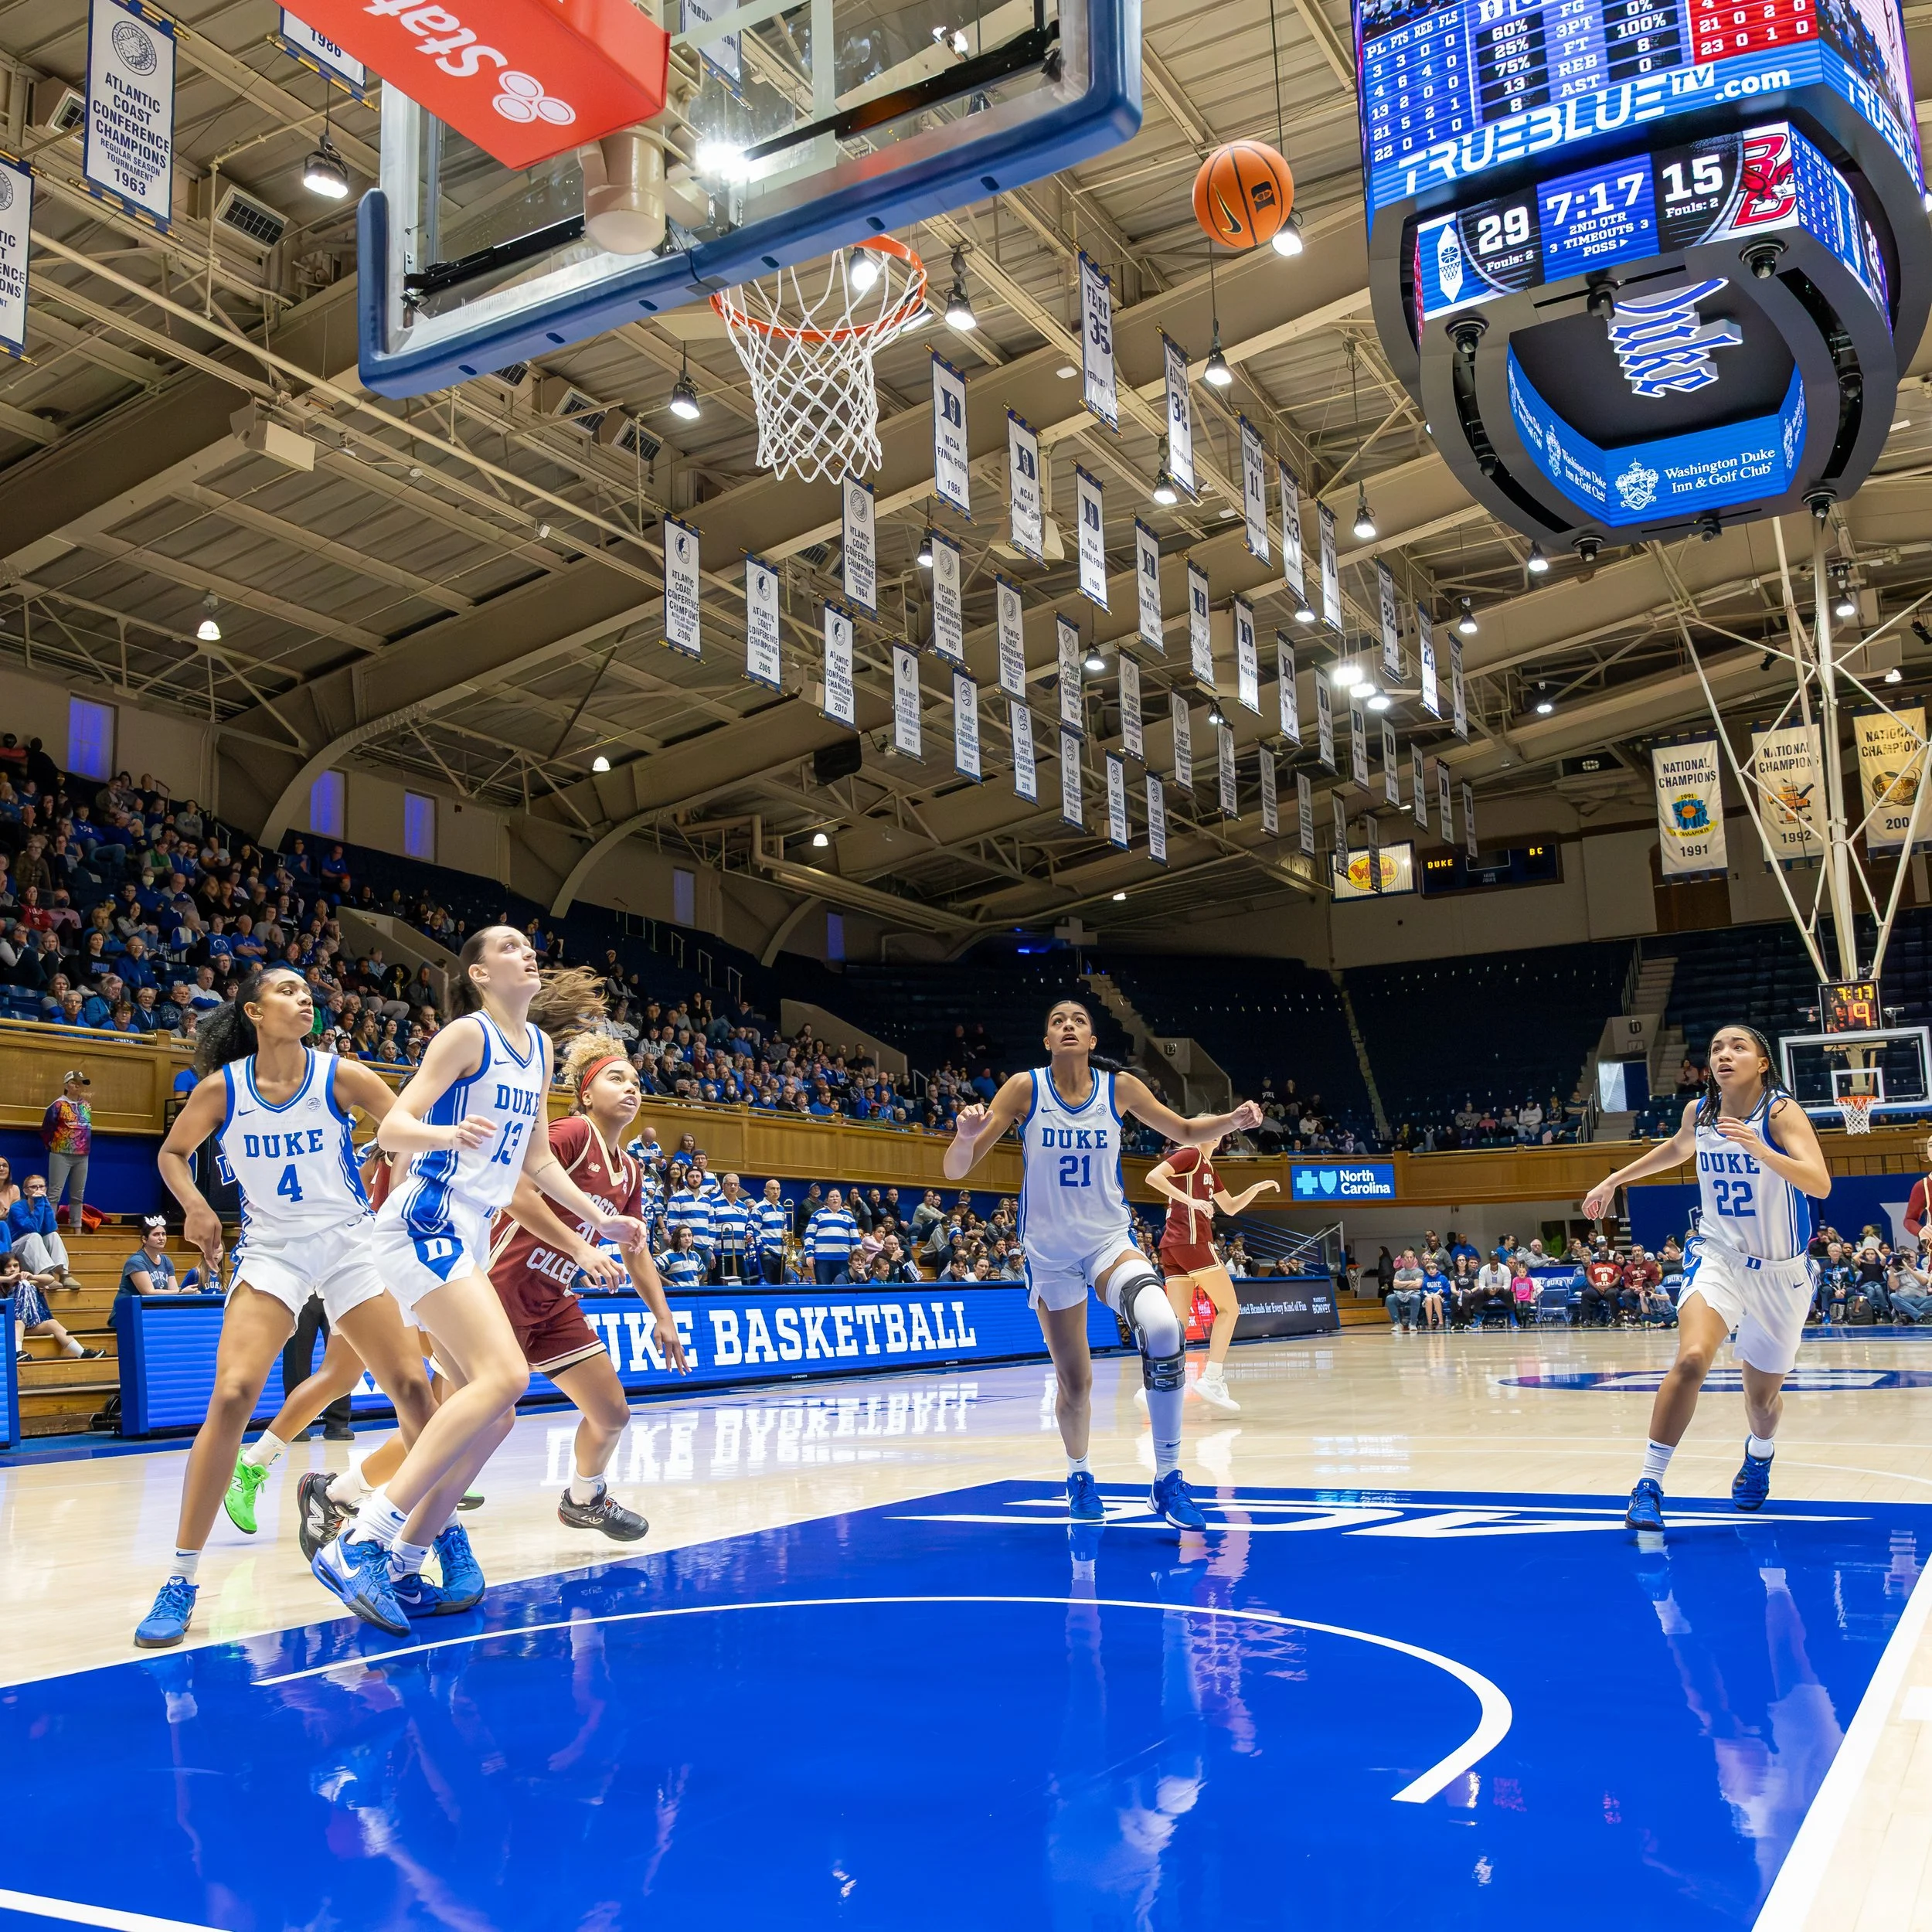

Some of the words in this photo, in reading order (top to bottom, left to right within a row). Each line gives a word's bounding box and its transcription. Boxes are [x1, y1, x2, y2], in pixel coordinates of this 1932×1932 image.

[1492, 19, 1528, 41] 60%
[1560, 2, 1585, 17] FG
[1627, 0, 1653, 16] 0%
[1699, 17, 1721, 33] 21
[1733, 11, 1746, 25] 0
[1764, 5, 1776, 18] 2
[1794, 0, 1805, 12] 0
[310, 28, 342, 58] 1986
[1366, 43, 1386, 59] PL
[1390, 31, 1409, 49] PTS
[1414, 22, 1433, 39] REB
[1438, 12, 1458, 29] FLS
[1495, 37, 1530, 60] 25%
[1556, 15, 1594, 39] 3PT
[1617, 11, 1667, 38] 100%
[1700, 39, 1724, 56] 23
[1736, 32, 1748, 46] 0
[1766, 27, 1778, 40] 1
[1796, 20, 1809, 33] 0
[1372, 64, 1383, 77] 3
[1396, 54, 1405, 67] 3
[1420, 44, 1430, 56] 0
[1444, 34, 1455, 47] 0
[1495, 56, 1531, 77] 75%
[1563, 36, 1589, 56] FT
[1638, 38, 1650, 52] 8
[1374, 85, 1384, 97] 4
[1398, 75, 1407, 88] 6
[1422, 65, 1432, 78] 4
[1447, 55, 1457, 68] 0
[1503, 79, 1526, 95] 13
[1558, 54, 1597, 77] REB
[1639, 58, 1651, 73] 0
[105, 72, 160, 114] ATLANTIC
[1372, 104, 1389, 121] 13
[1400, 95, 1409, 108] 2
[1423, 85, 1434, 98] 0
[1448, 76, 1458, 89] 0
[1511, 97, 1522, 112] 8
[1560, 74, 1600, 97] AST
[114, 94, 151, 125] COAST
[1373, 124, 1390, 141] 21
[1401, 116, 1410, 129] 5
[1425, 107, 1434, 120] 2
[1451, 97, 1460, 110] 1
[93, 100, 170, 154] CONFERENCE
[96, 119, 166, 168] CHAMPIONS
[1374, 145, 1393, 162] 22
[1403, 137, 1412, 150] 0
[1427, 128, 1436, 141] 1
[1451, 118, 1462, 131] 0
[100, 138, 131, 162] REGULAR
[133, 156, 160, 176] SEASON
[107, 151, 153, 183] TOURNAMENT
[114, 168, 146, 196] 1963
[1478, 206, 1529, 255] 29
[1546, 172, 1645, 226] 7:17
[1662, 155, 1723, 202] 15
[1665, 197, 1707, 219] Fouls:
[1709, 196, 1719, 209] 2
[1549, 243, 1558, 253] 3
[1563, 223, 1634, 251] TIMEOUTS
[1641, 219, 1648, 230] 3
[1569, 221, 1597, 236] 2ND
[1600, 212, 1627, 231] QTR
[1485, 252, 1522, 273] Fouls:
[1525, 249, 1534, 261] 2
[1583, 239, 1617, 258] POSS
[1089, 311, 1112, 355] 35
[937, 446, 954, 464] FINAL
[945, 434, 960, 452] NCAA
[1561, 448, 1592, 479] Washington
[1592, 470, 1607, 490] Duke
[1663, 457, 1737, 481] Washington
[1741, 448, 1776, 466] Duke
[1249, 471, 1260, 502] 11
[1565, 465, 1574, 481] Inn
[1580, 476, 1592, 495] Golf
[1672, 480, 1693, 495] Inn
[1696, 476, 1708, 488] &
[1710, 468, 1736, 487] Golf
[1740, 462, 1770, 478] Club
[1020, 487, 1034, 503] NCAA
[850, 526, 870, 545] ATLANTIC
[852, 539, 867, 553] COAST
[845, 544, 875, 570] CONFERENCE
[1081, 548, 1094, 563] FINAL
[672, 570, 694, 588] ATLANTIC
[675, 582, 692, 597] COAST
[939, 583, 957, 600] ATLANTIC
[668, 589, 699, 612] CONFERENCE
[855, 585, 868, 599] 1964
[669, 600, 699, 622] CHAMPIONS
[753, 606, 775, 623] ATLANTIC
[935, 601, 962, 622] CONFERENCE
[748, 624, 778, 646] CONFERENCE
[757, 617, 772, 631] COAST
[750, 636, 777, 655] CHAMPIONS
[829, 650, 849, 667] ATLANTIC
[1002, 652, 1024, 670] CHAMPIONS
[834, 702, 848, 715] 2010
[1662, 757, 1710, 774] NATIONAL
[1658, 770, 1716, 788] CHAMPIONS
[1781, 829, 1811, 843] 1992
[1886, 817, 1912, 830] 200
[1679, 844, 1709, 858] 1991
[1427, 859, 1454, 869] DUKE
[1836, 985, 1873, 1002] 7:17
[1853, 1002, 1871, 1027] 9
[495, 1083, 540, 1117] DUKE
[243, 1128, 324, 1158] DUKE
[491, 1121, 524, 1165] 13
[1042, 1127, 1108, 1149] DUKE
[1060, 1155, 1091, 1187] 21
[1339, 1169, 1375, 1182] North
[1699, 1151, 1760, 1175] DUKE
[277, 1163, 304, 1203] 4
[1341, 1182, 1391, 1194] Carolina
[1713, 1179, 1756, 1217] 22
[526, 1247, 580, 1284] CLLE
[1546, 1277, 1563, 1287] DUKE
[1250, 1301, 1264, 1314] Brands
[1271, 1301, 1284, 1315] Every
[1283, 1301, 1294, 1312] Kind
[1294, 1301, 1300, 1311] of
[1299, 1300, 1308, 1311] Fun
[586, 1311, 699, 1372] UKE
[709, 1301, 977, 1366] BASKETBALL
